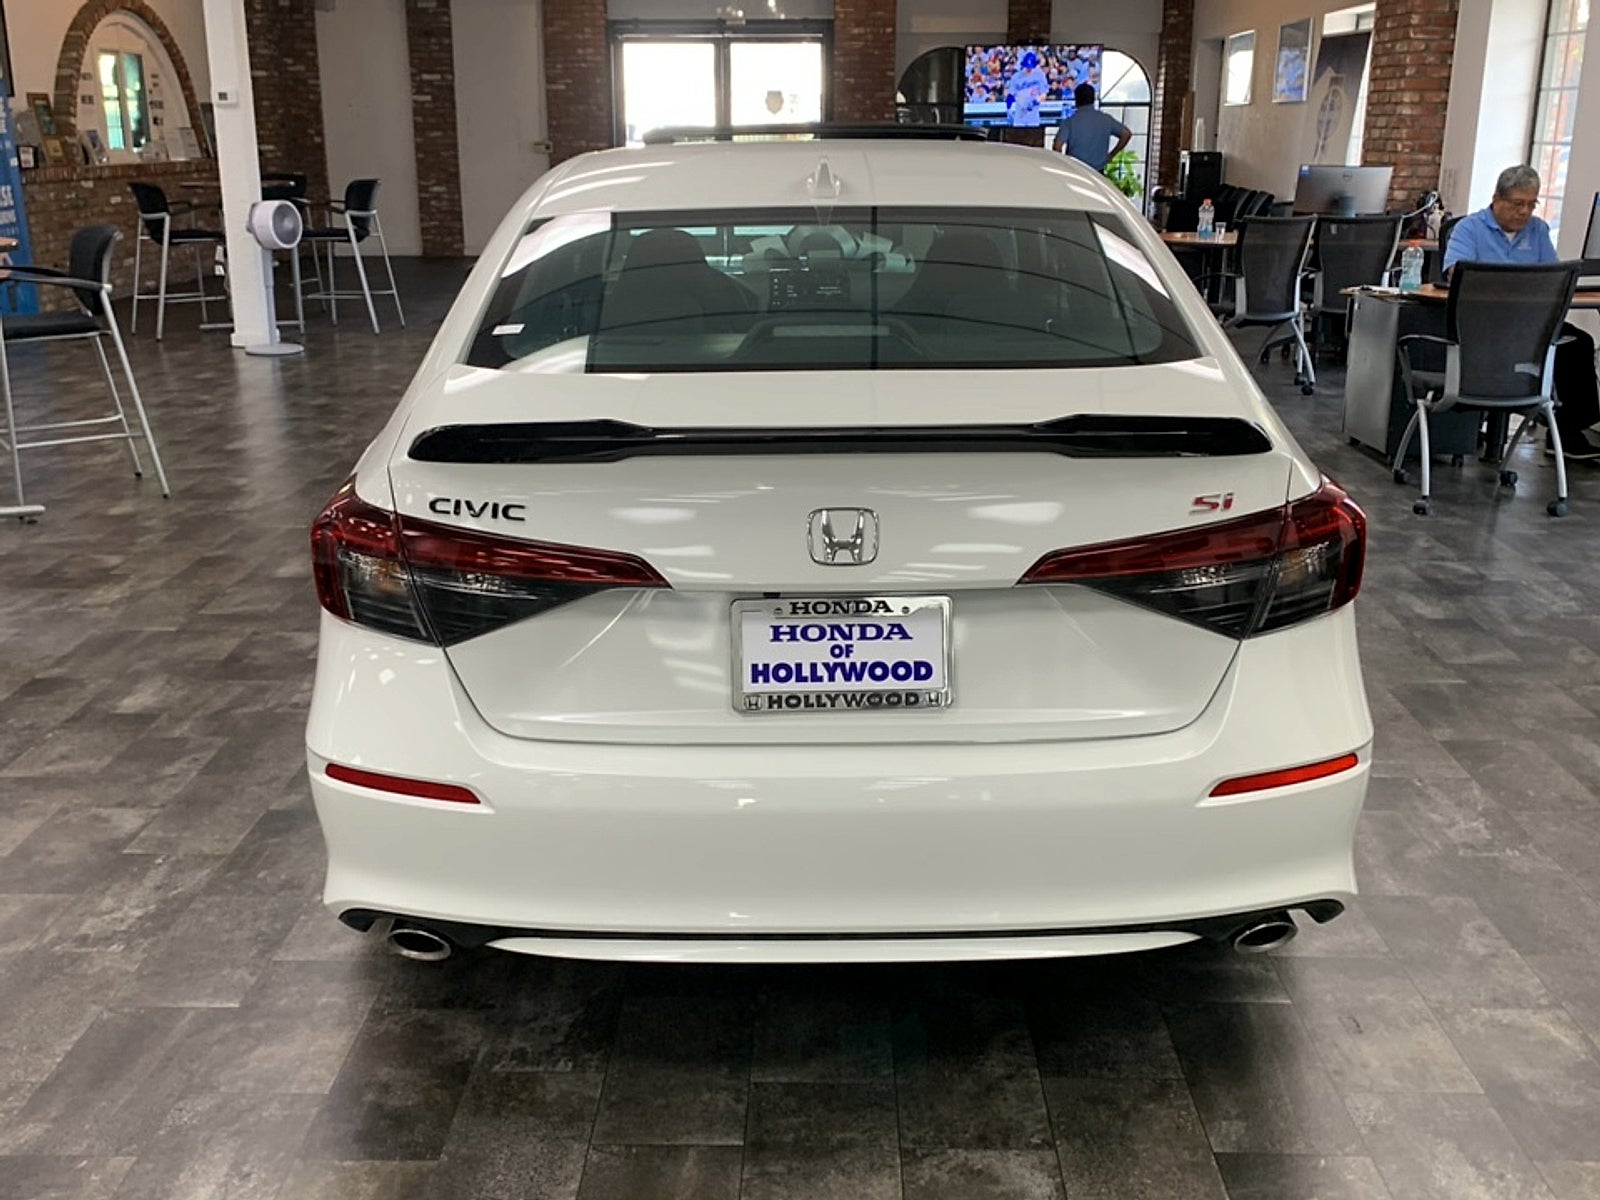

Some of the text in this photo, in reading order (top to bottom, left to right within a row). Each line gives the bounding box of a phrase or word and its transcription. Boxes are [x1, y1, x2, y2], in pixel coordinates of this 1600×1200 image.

[429, 497, 526, 521] CIVIC
[1189, 492, 1234, 515] Si
[789, 600, 894, 615] HONDA
[770, 623, 913, 642] HONDA
[829, 643, 854, 659] OF
[750, 661, 933, 684] HOLLYWOOD
[767, 692, 919, 709] HOLLYWOOD
